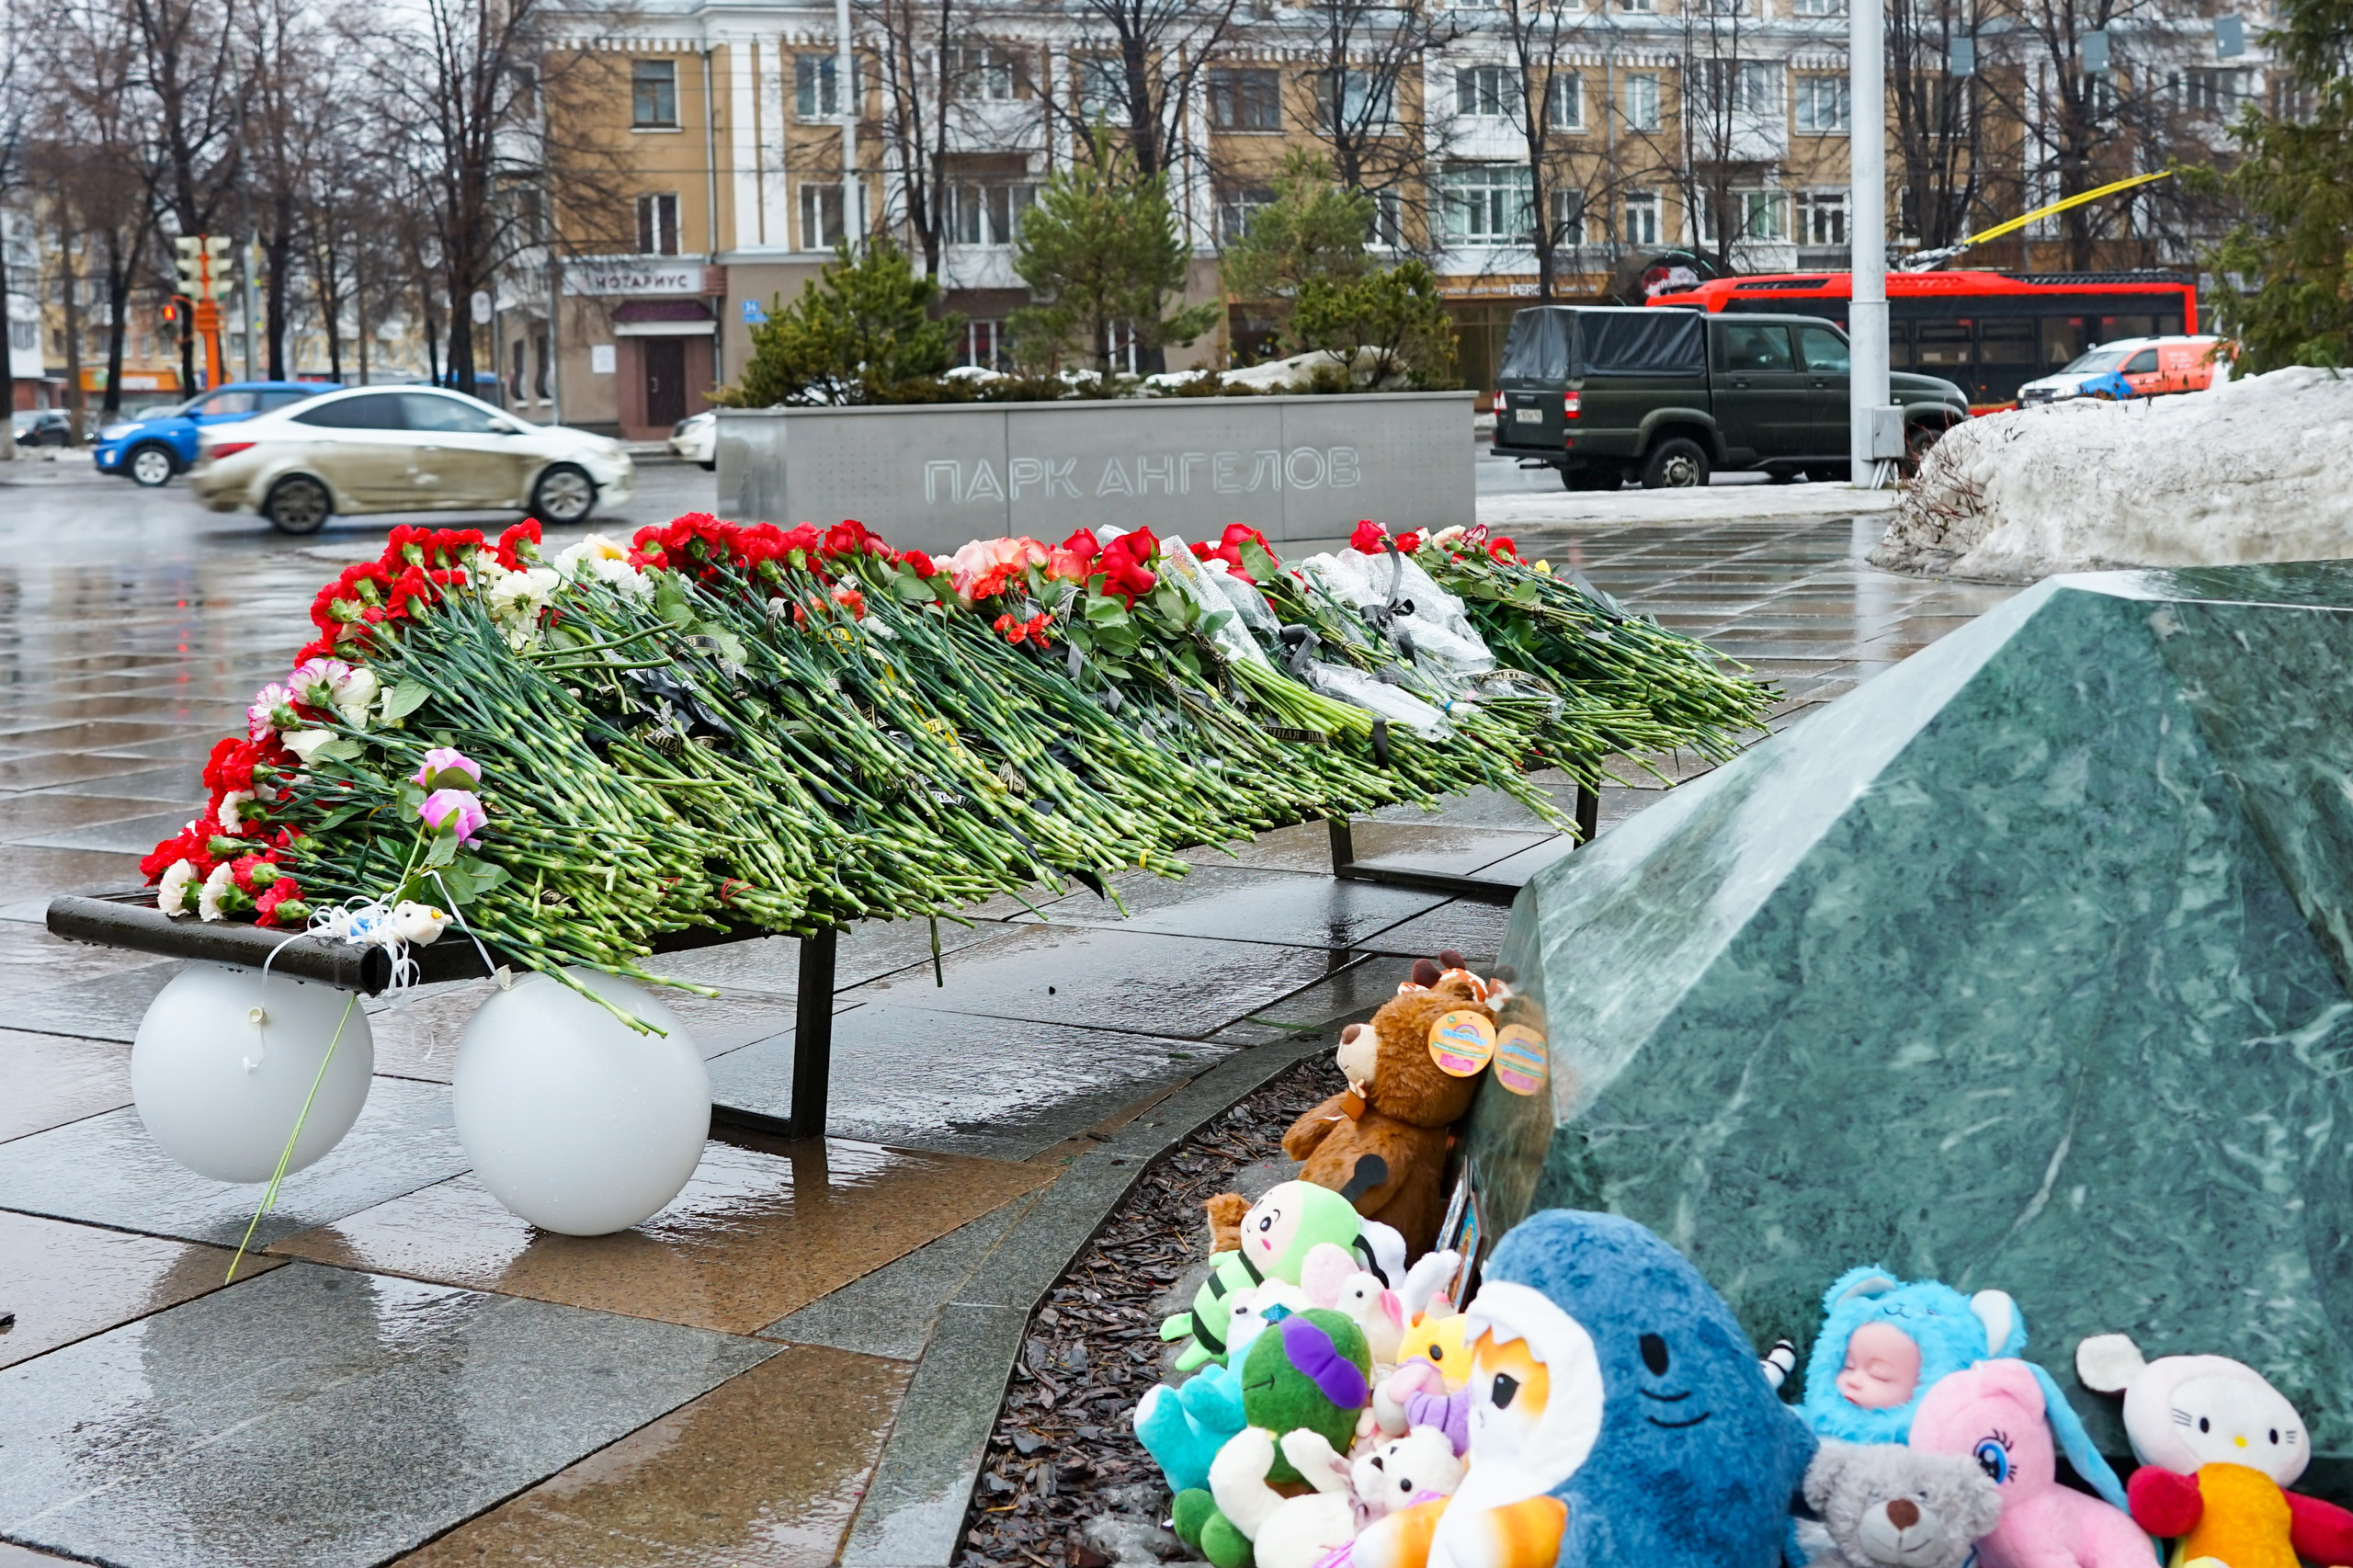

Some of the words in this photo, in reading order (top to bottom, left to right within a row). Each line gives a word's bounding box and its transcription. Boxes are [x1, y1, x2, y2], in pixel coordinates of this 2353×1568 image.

[597, 275, 688, 289] НОТАРИУС
[1509, 283, 1554, 297] PERG
[924, 457, 1082, 504] ПАРК
[1096, 446, 1360, 497] АНГЕЛОВ
